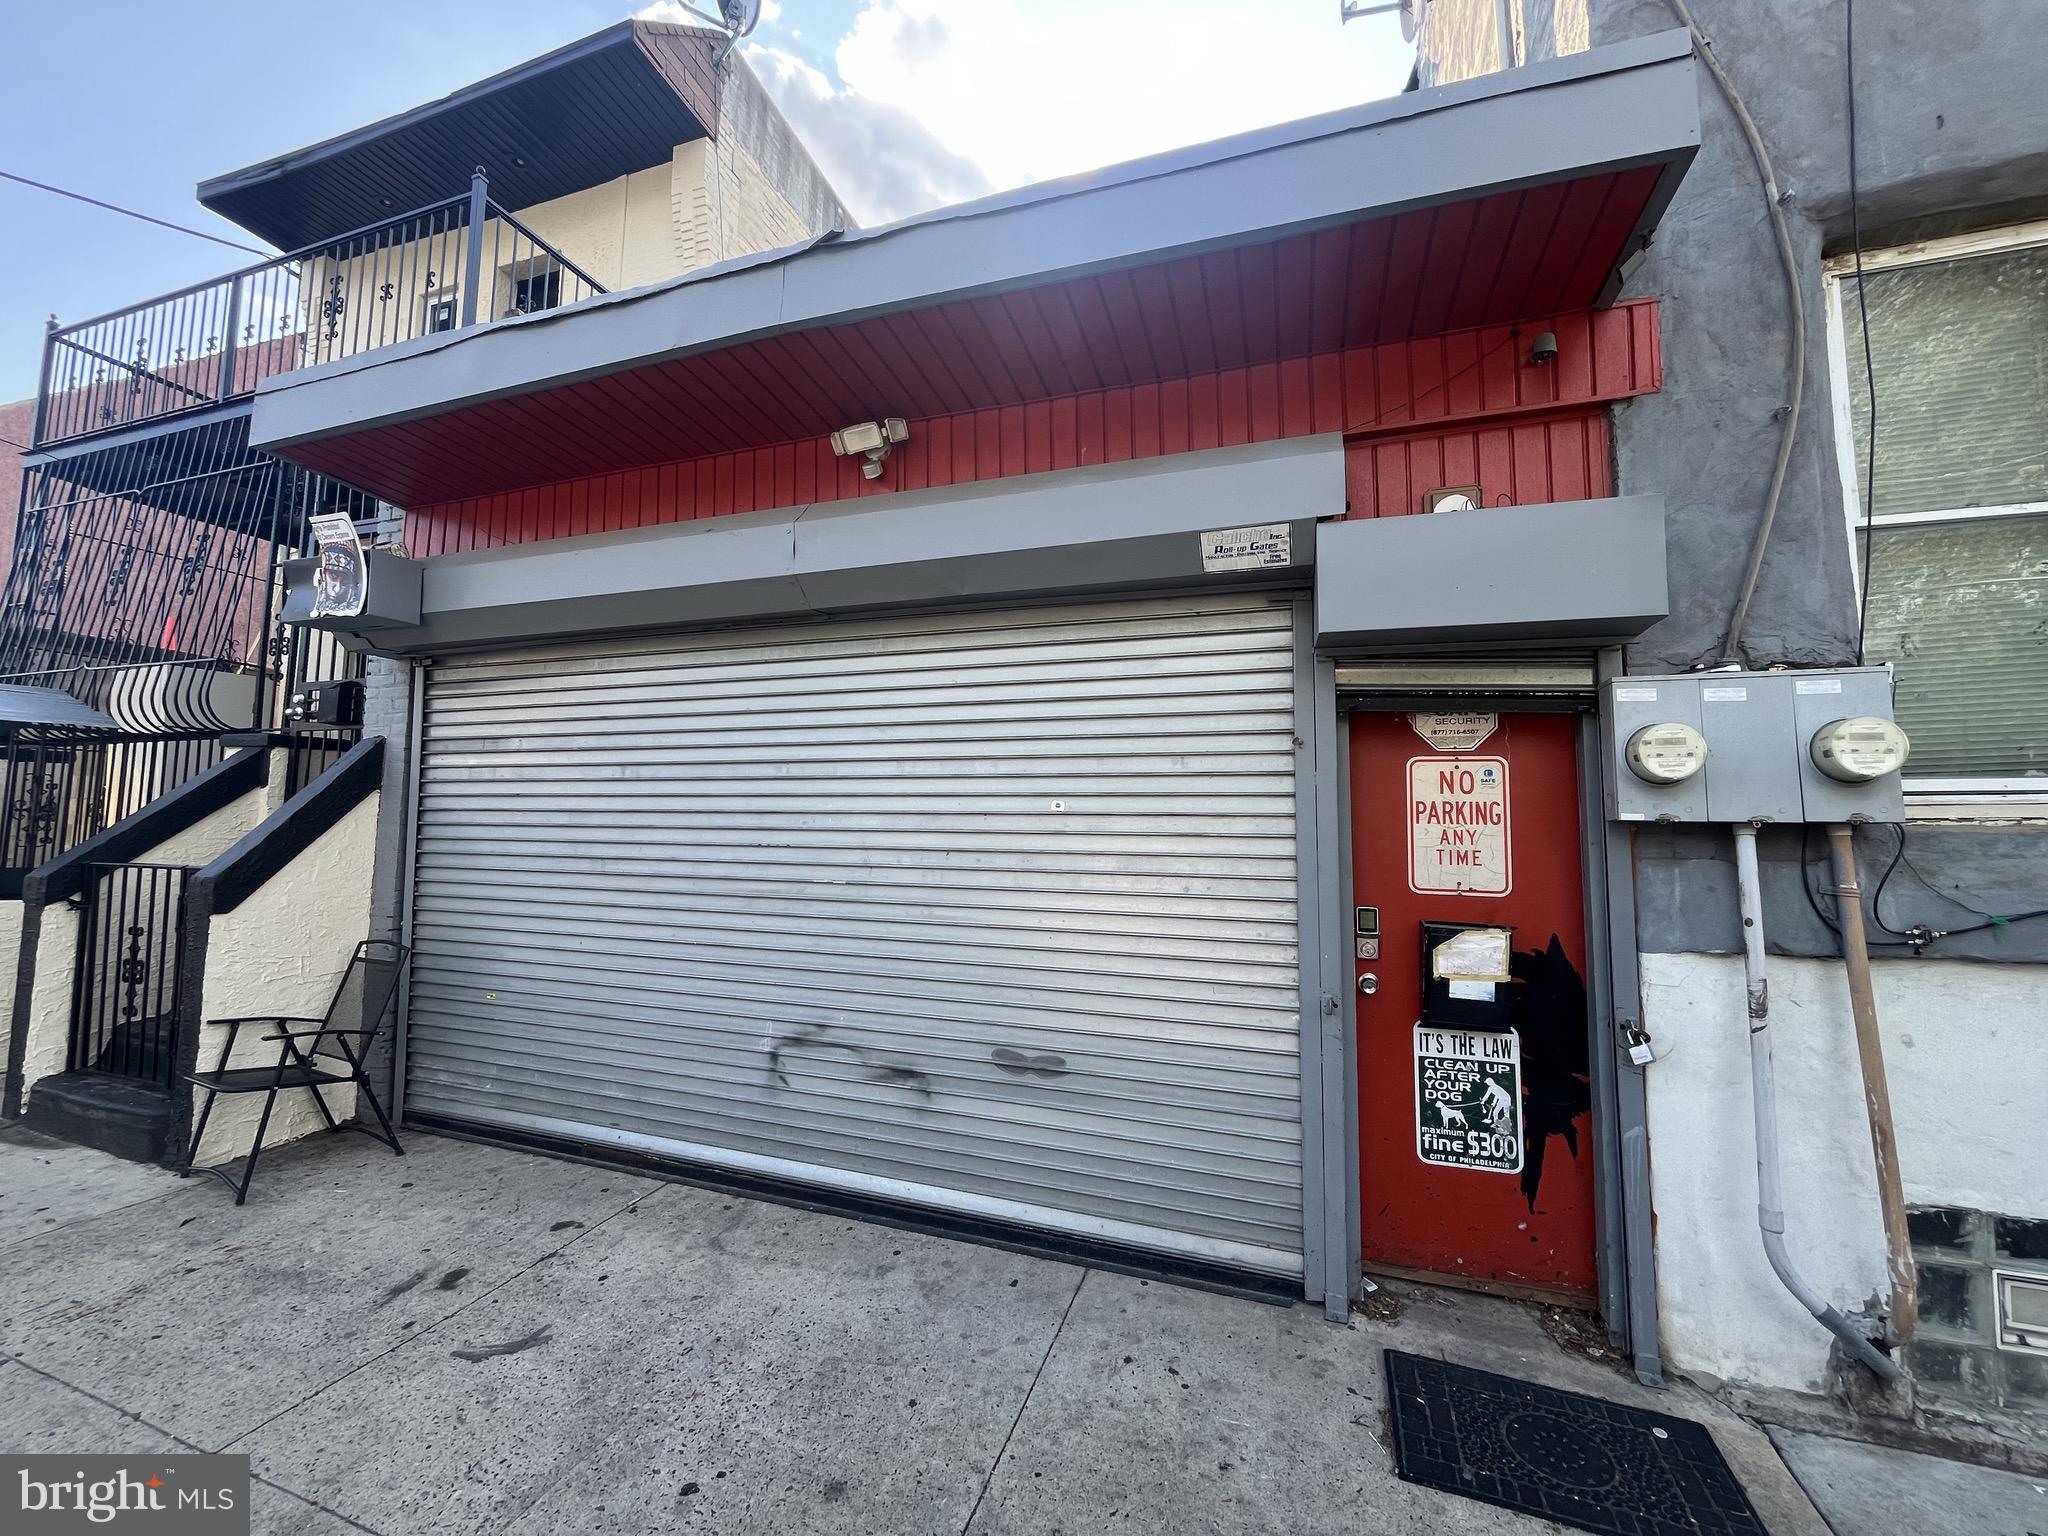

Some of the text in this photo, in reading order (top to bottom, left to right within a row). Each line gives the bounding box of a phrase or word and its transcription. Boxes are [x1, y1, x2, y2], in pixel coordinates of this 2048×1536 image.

[1214, 541, 1278, 554] Roll-up Gates
[1435, 716, 1490, 726] SECURITY
[1440, 771, 1475, 795] NO
[1416, 801, 1501, 826] PARKING
[1440, 829, 1477, 846] ANY
[1436, 849, 1482, 866] TIME
[1419, 1032, 1512, 1059] IT'S THE LAW
[1424, 1058, 1510, 1074] CLEAN UP
[1424, 1069, 1481, 1083] AFTER
[1424, 1079, 1472, 1092] YOUR
[1425, 1089, 1462, 1101] DOG
[1422, 1126, 1465, 1137] maximum
[1423, 1129, 1517, 1160] fine $300
[1430, 1153, 1445, 1161] CITY
[1459, 1156, 1510, 1168] PHILADELPHIA
